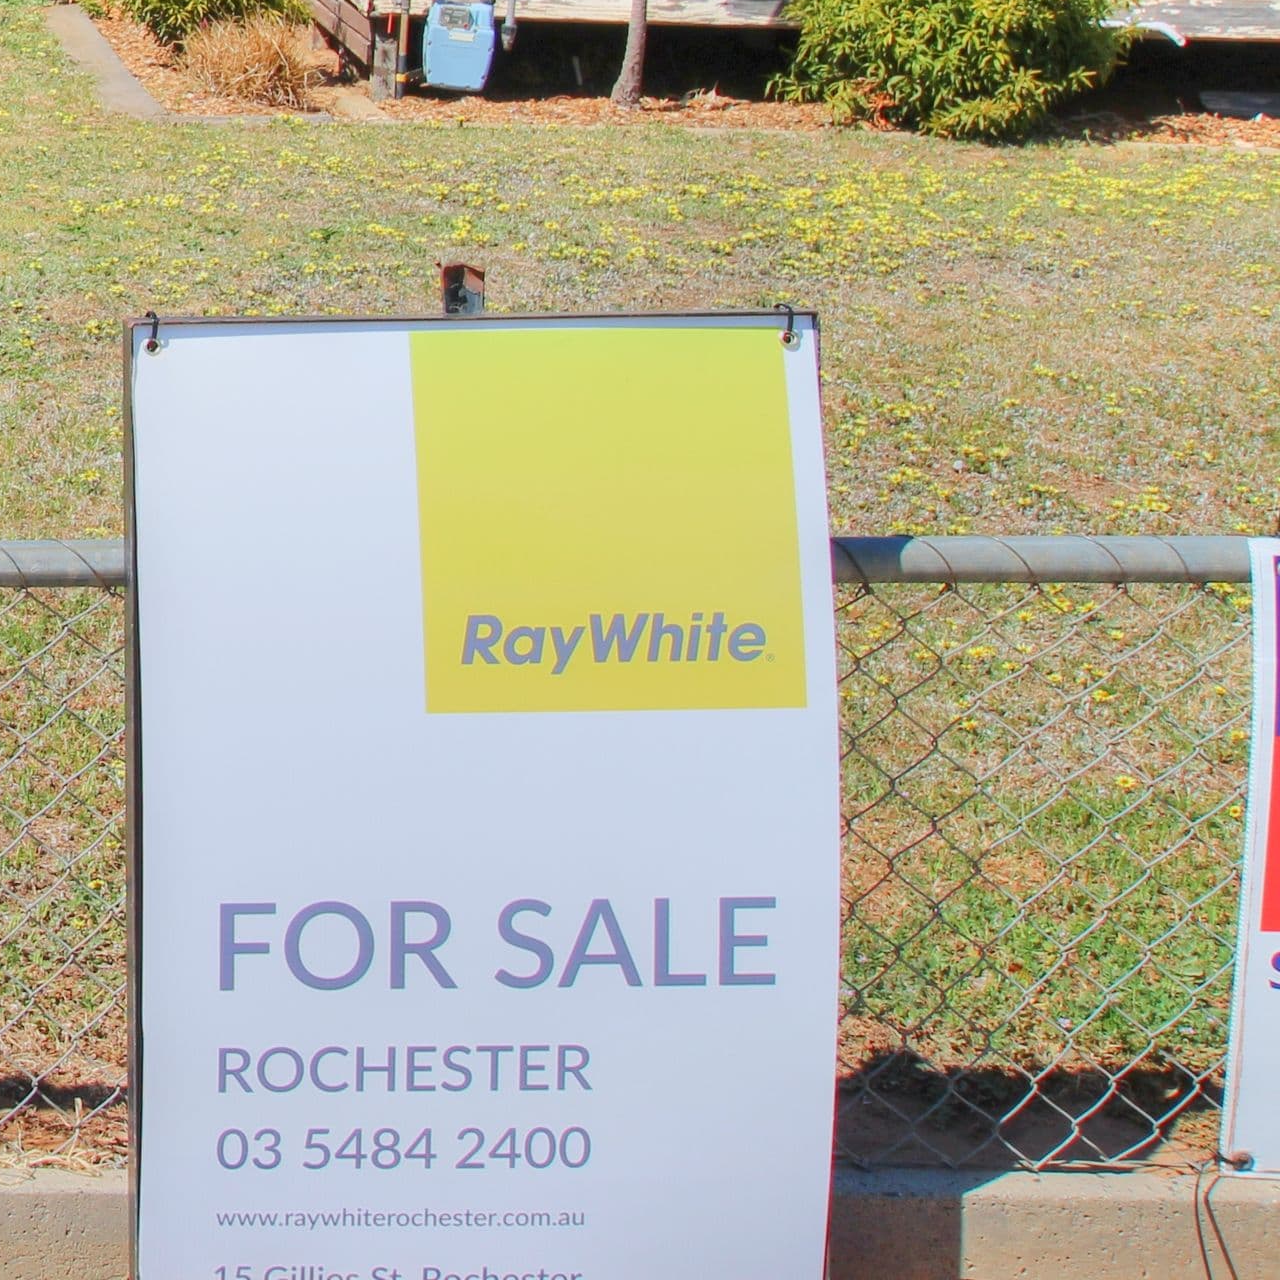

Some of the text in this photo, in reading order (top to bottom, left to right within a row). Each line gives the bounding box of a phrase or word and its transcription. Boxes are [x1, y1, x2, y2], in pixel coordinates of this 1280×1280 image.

[218, 897, 777, 992] FOR SALE
[217, 1045, 593, 1094] ROCHESTER
[216, 1126, 592, 1171] 03 5484 2400
[216, 1207, 585, 1231] www.raywhiterochester.com.au
